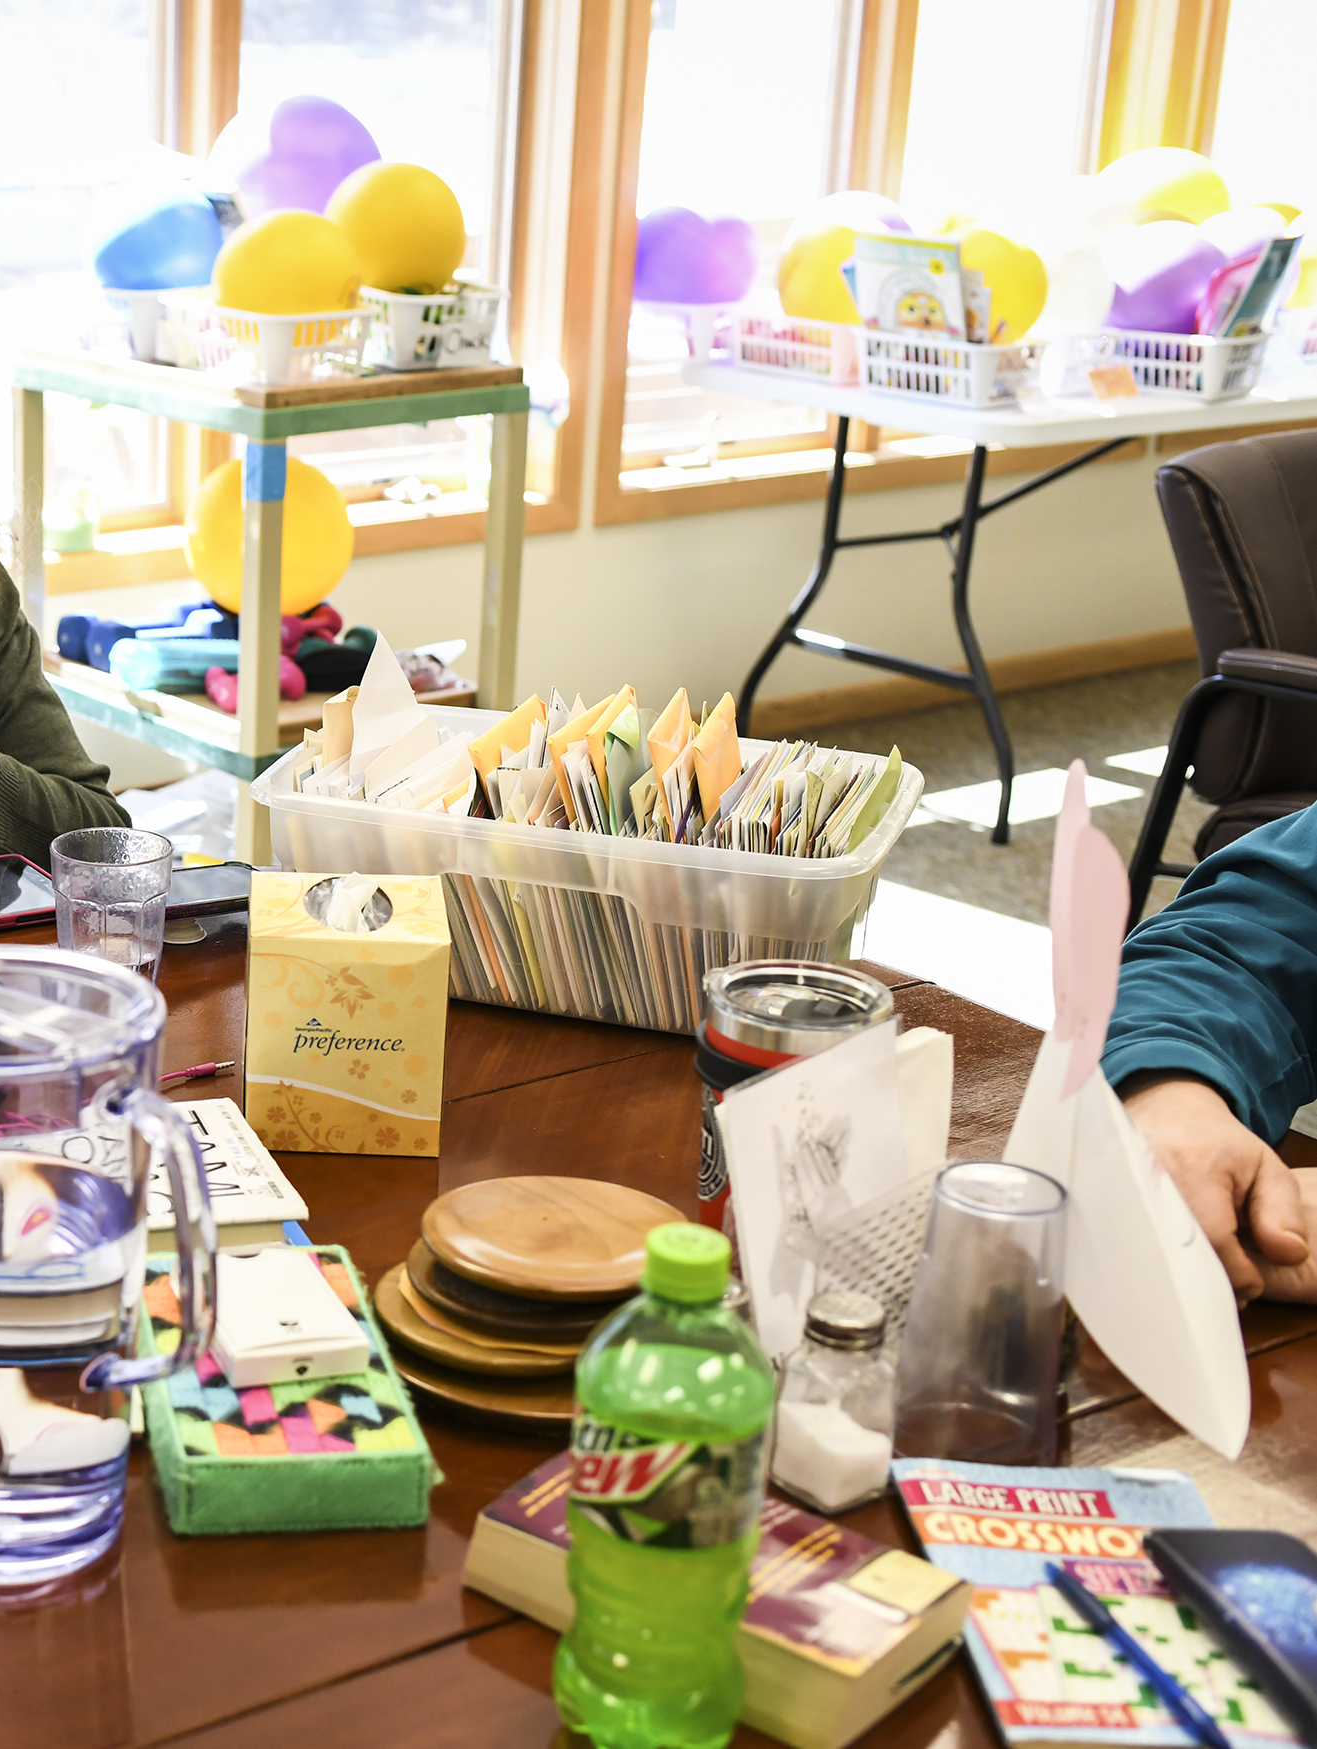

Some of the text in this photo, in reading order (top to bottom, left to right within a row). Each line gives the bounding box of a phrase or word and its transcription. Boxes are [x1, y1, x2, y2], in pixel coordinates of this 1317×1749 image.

[293, 1030, 403, 1056] preference
[920, 1481, 1100, 1516] LARGE PRINT
